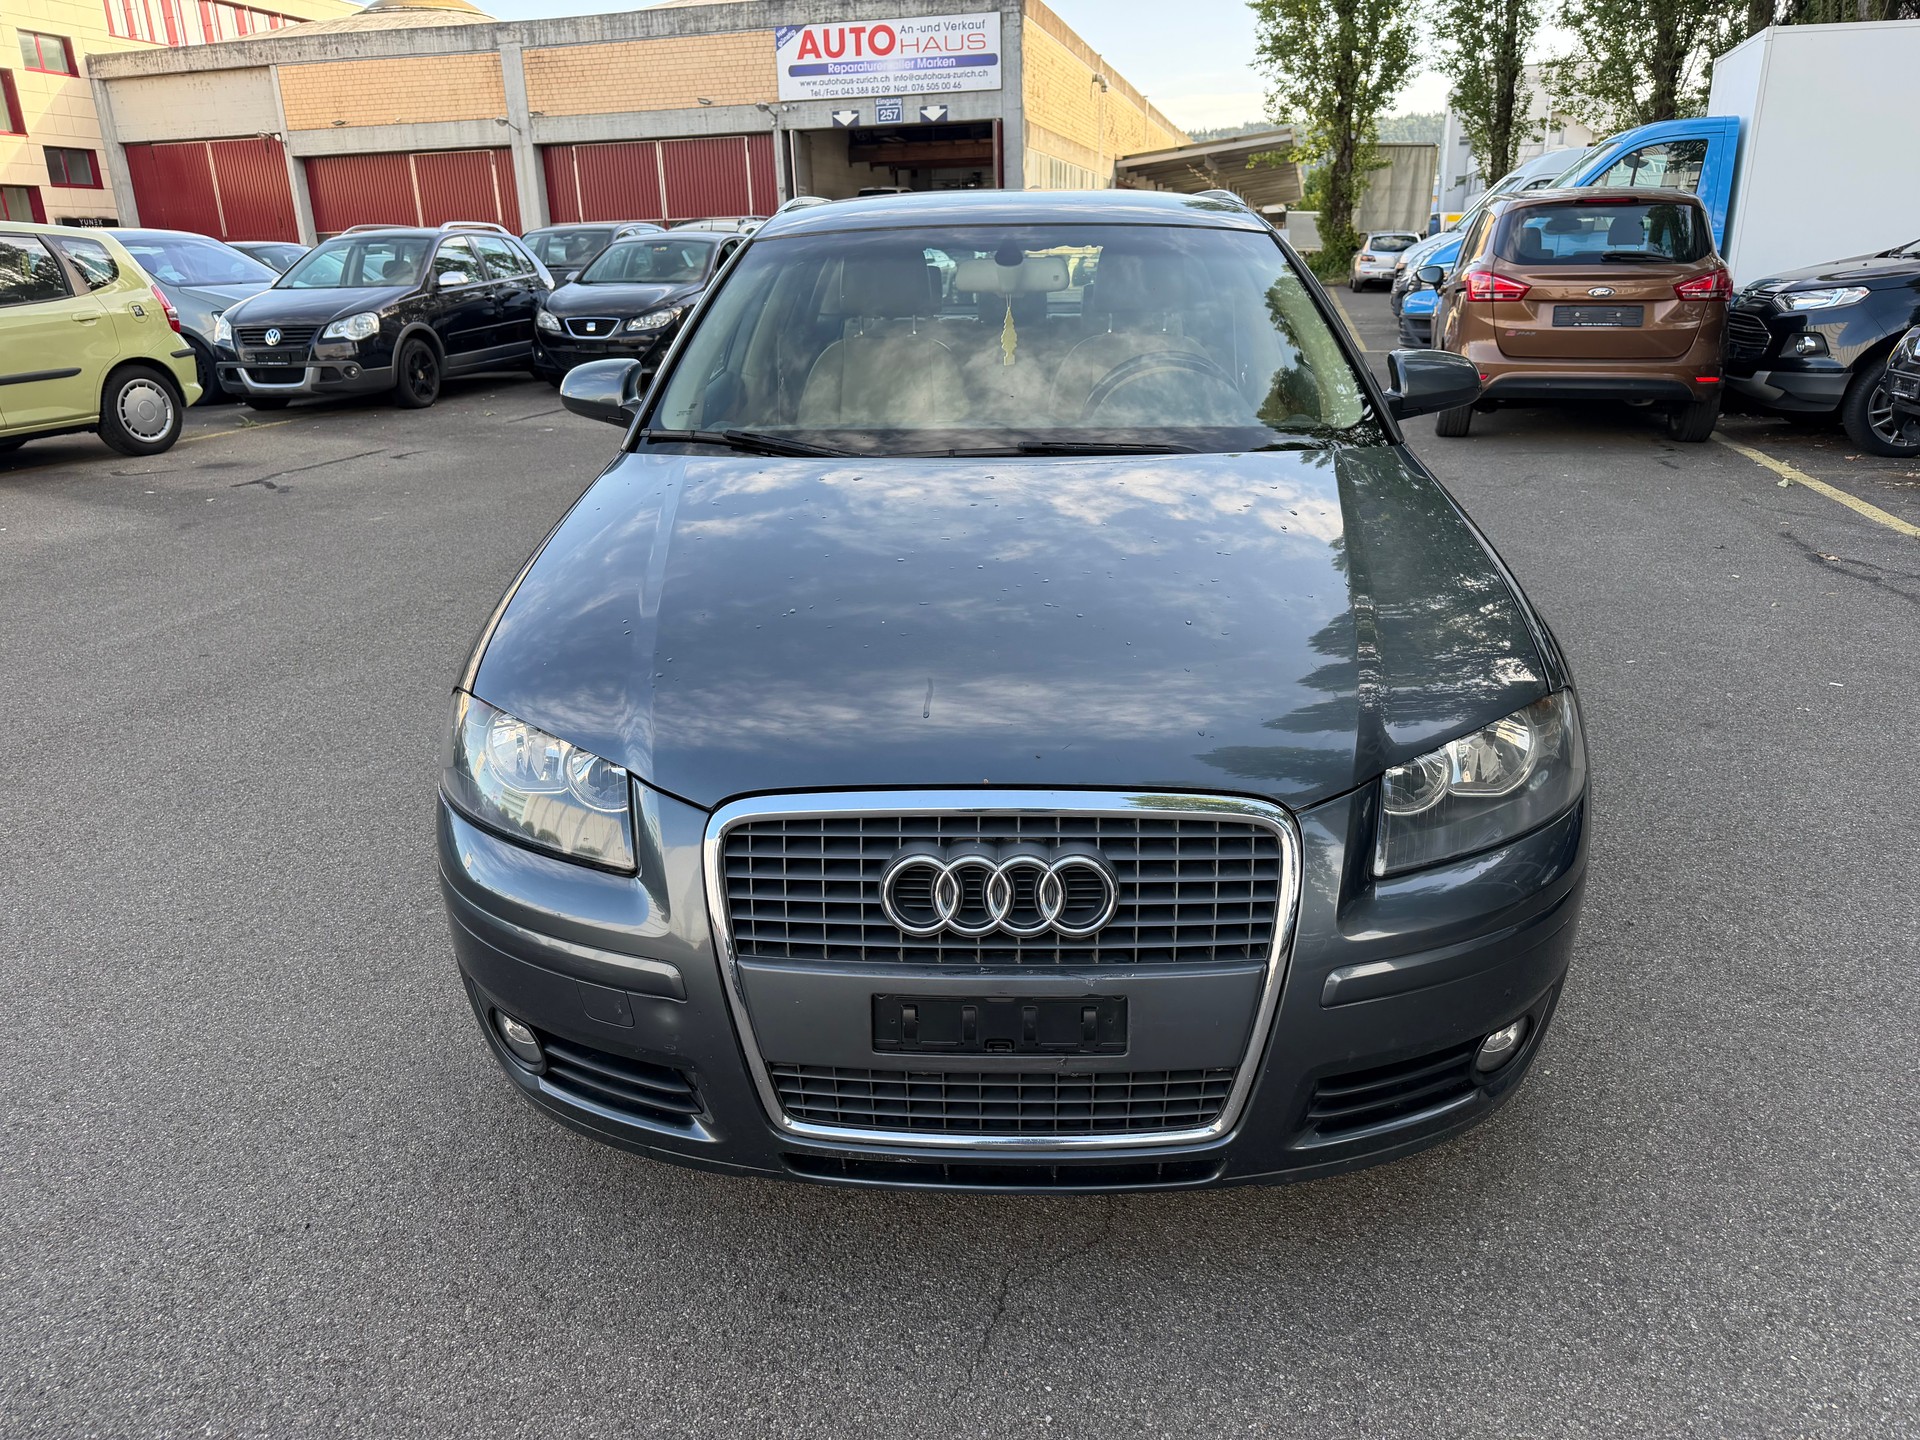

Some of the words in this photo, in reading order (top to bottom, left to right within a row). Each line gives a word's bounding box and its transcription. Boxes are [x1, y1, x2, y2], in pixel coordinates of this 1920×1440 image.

[900, 25, 914, 34] An
[916, 23, 941, 33] -und
[943, 19, 986, 31] Verkauf
[797, 24, 896, 60] AUTO
[900, 33, 986, 54] HAUS
[828, 60, 889, 75] Reparaturen
[917, 57, 956, 67] Marken
[799, 74, 890, 87] www.autohaus-zurich.ch
[893, 69, 989, 82] info@autohaus-zurich.ch
[811, 88, 839, 97] Tel./Fax
[841, 87, 854, 95] 043
[871, 86, 880, 94] 82
[881, 85, 890, 93] 09
[911, 83, 925, 92] 076
[926, 82, 939, 91] 505
[941, 81, 951, 90] 00
[876, 97, 902, 106] Eingang
[880, 109, 899, 120] 257
[79, 218, 104, 226] YUNEX
